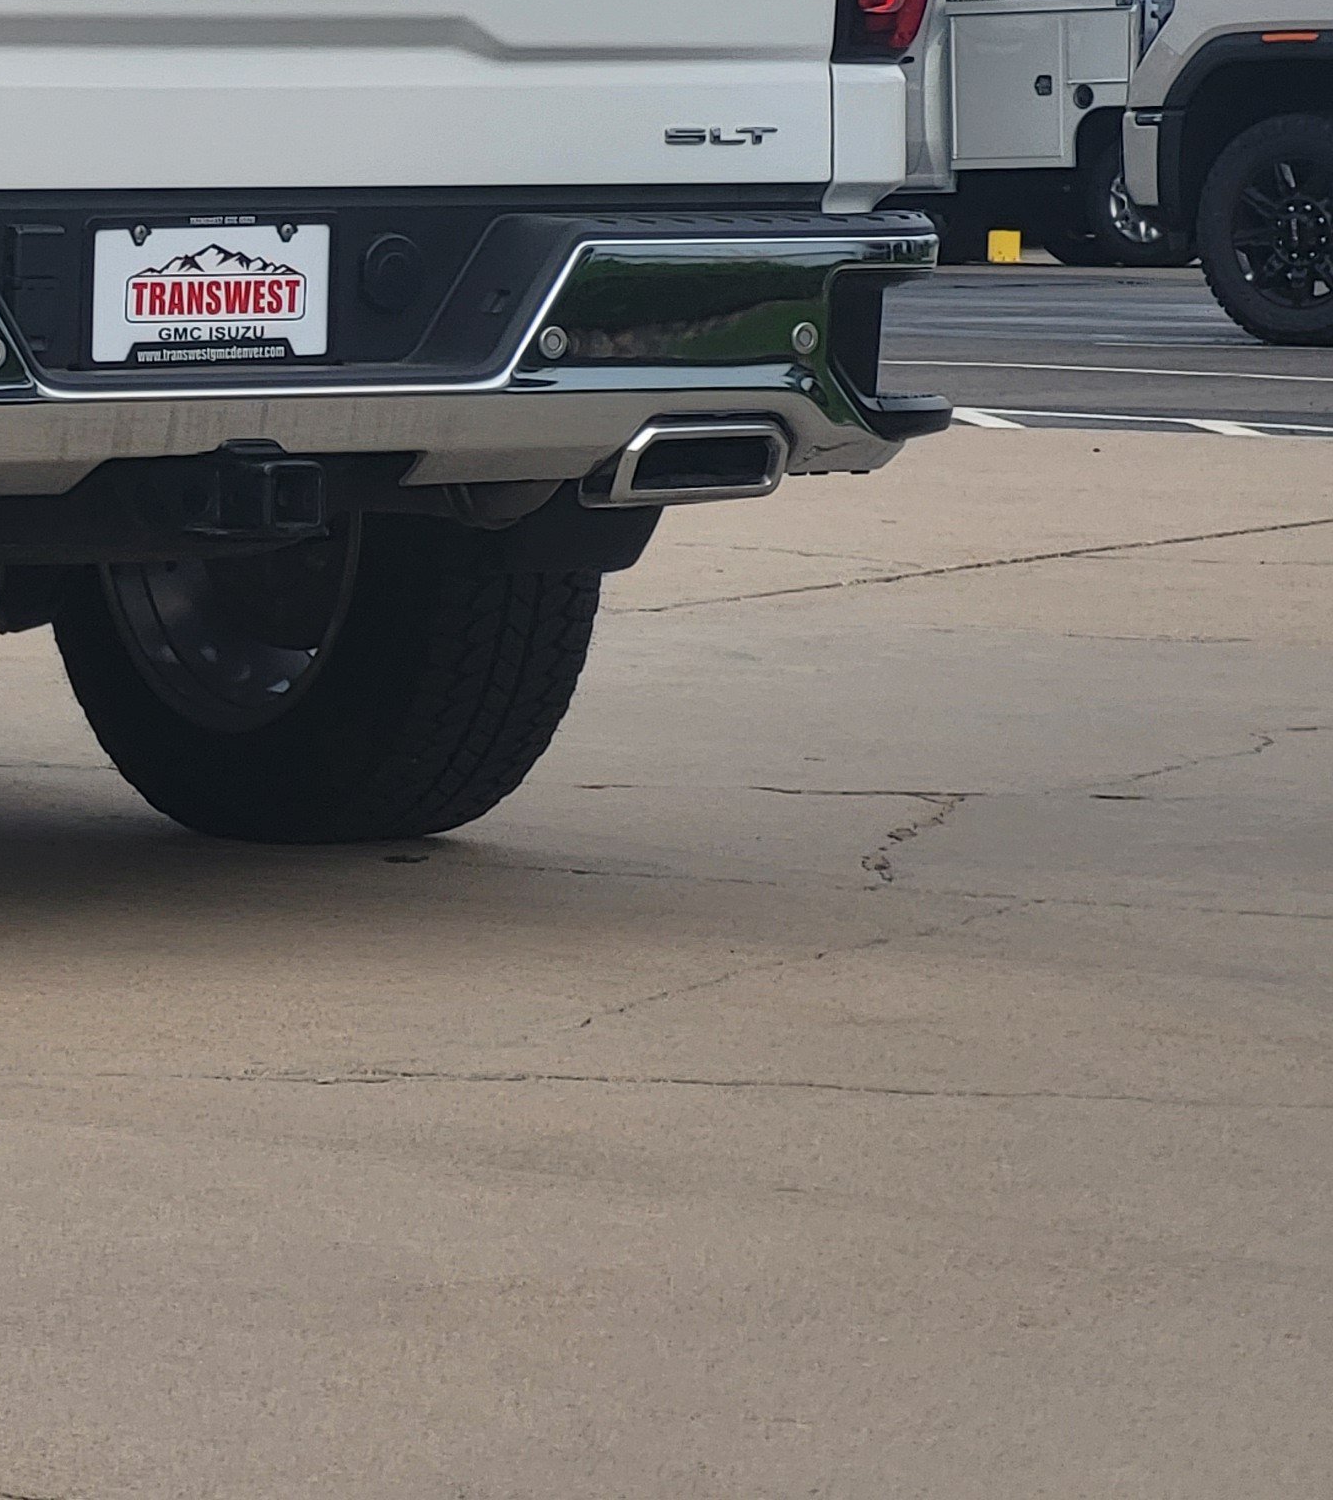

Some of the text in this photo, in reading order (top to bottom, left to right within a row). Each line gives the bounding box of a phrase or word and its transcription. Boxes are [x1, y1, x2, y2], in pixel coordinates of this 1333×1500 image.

[664, 126, 778, 145] SLT
[132, 280, 300, 316] TRANSWEST
[158, 325, 265, 341] GMC ISUZU
